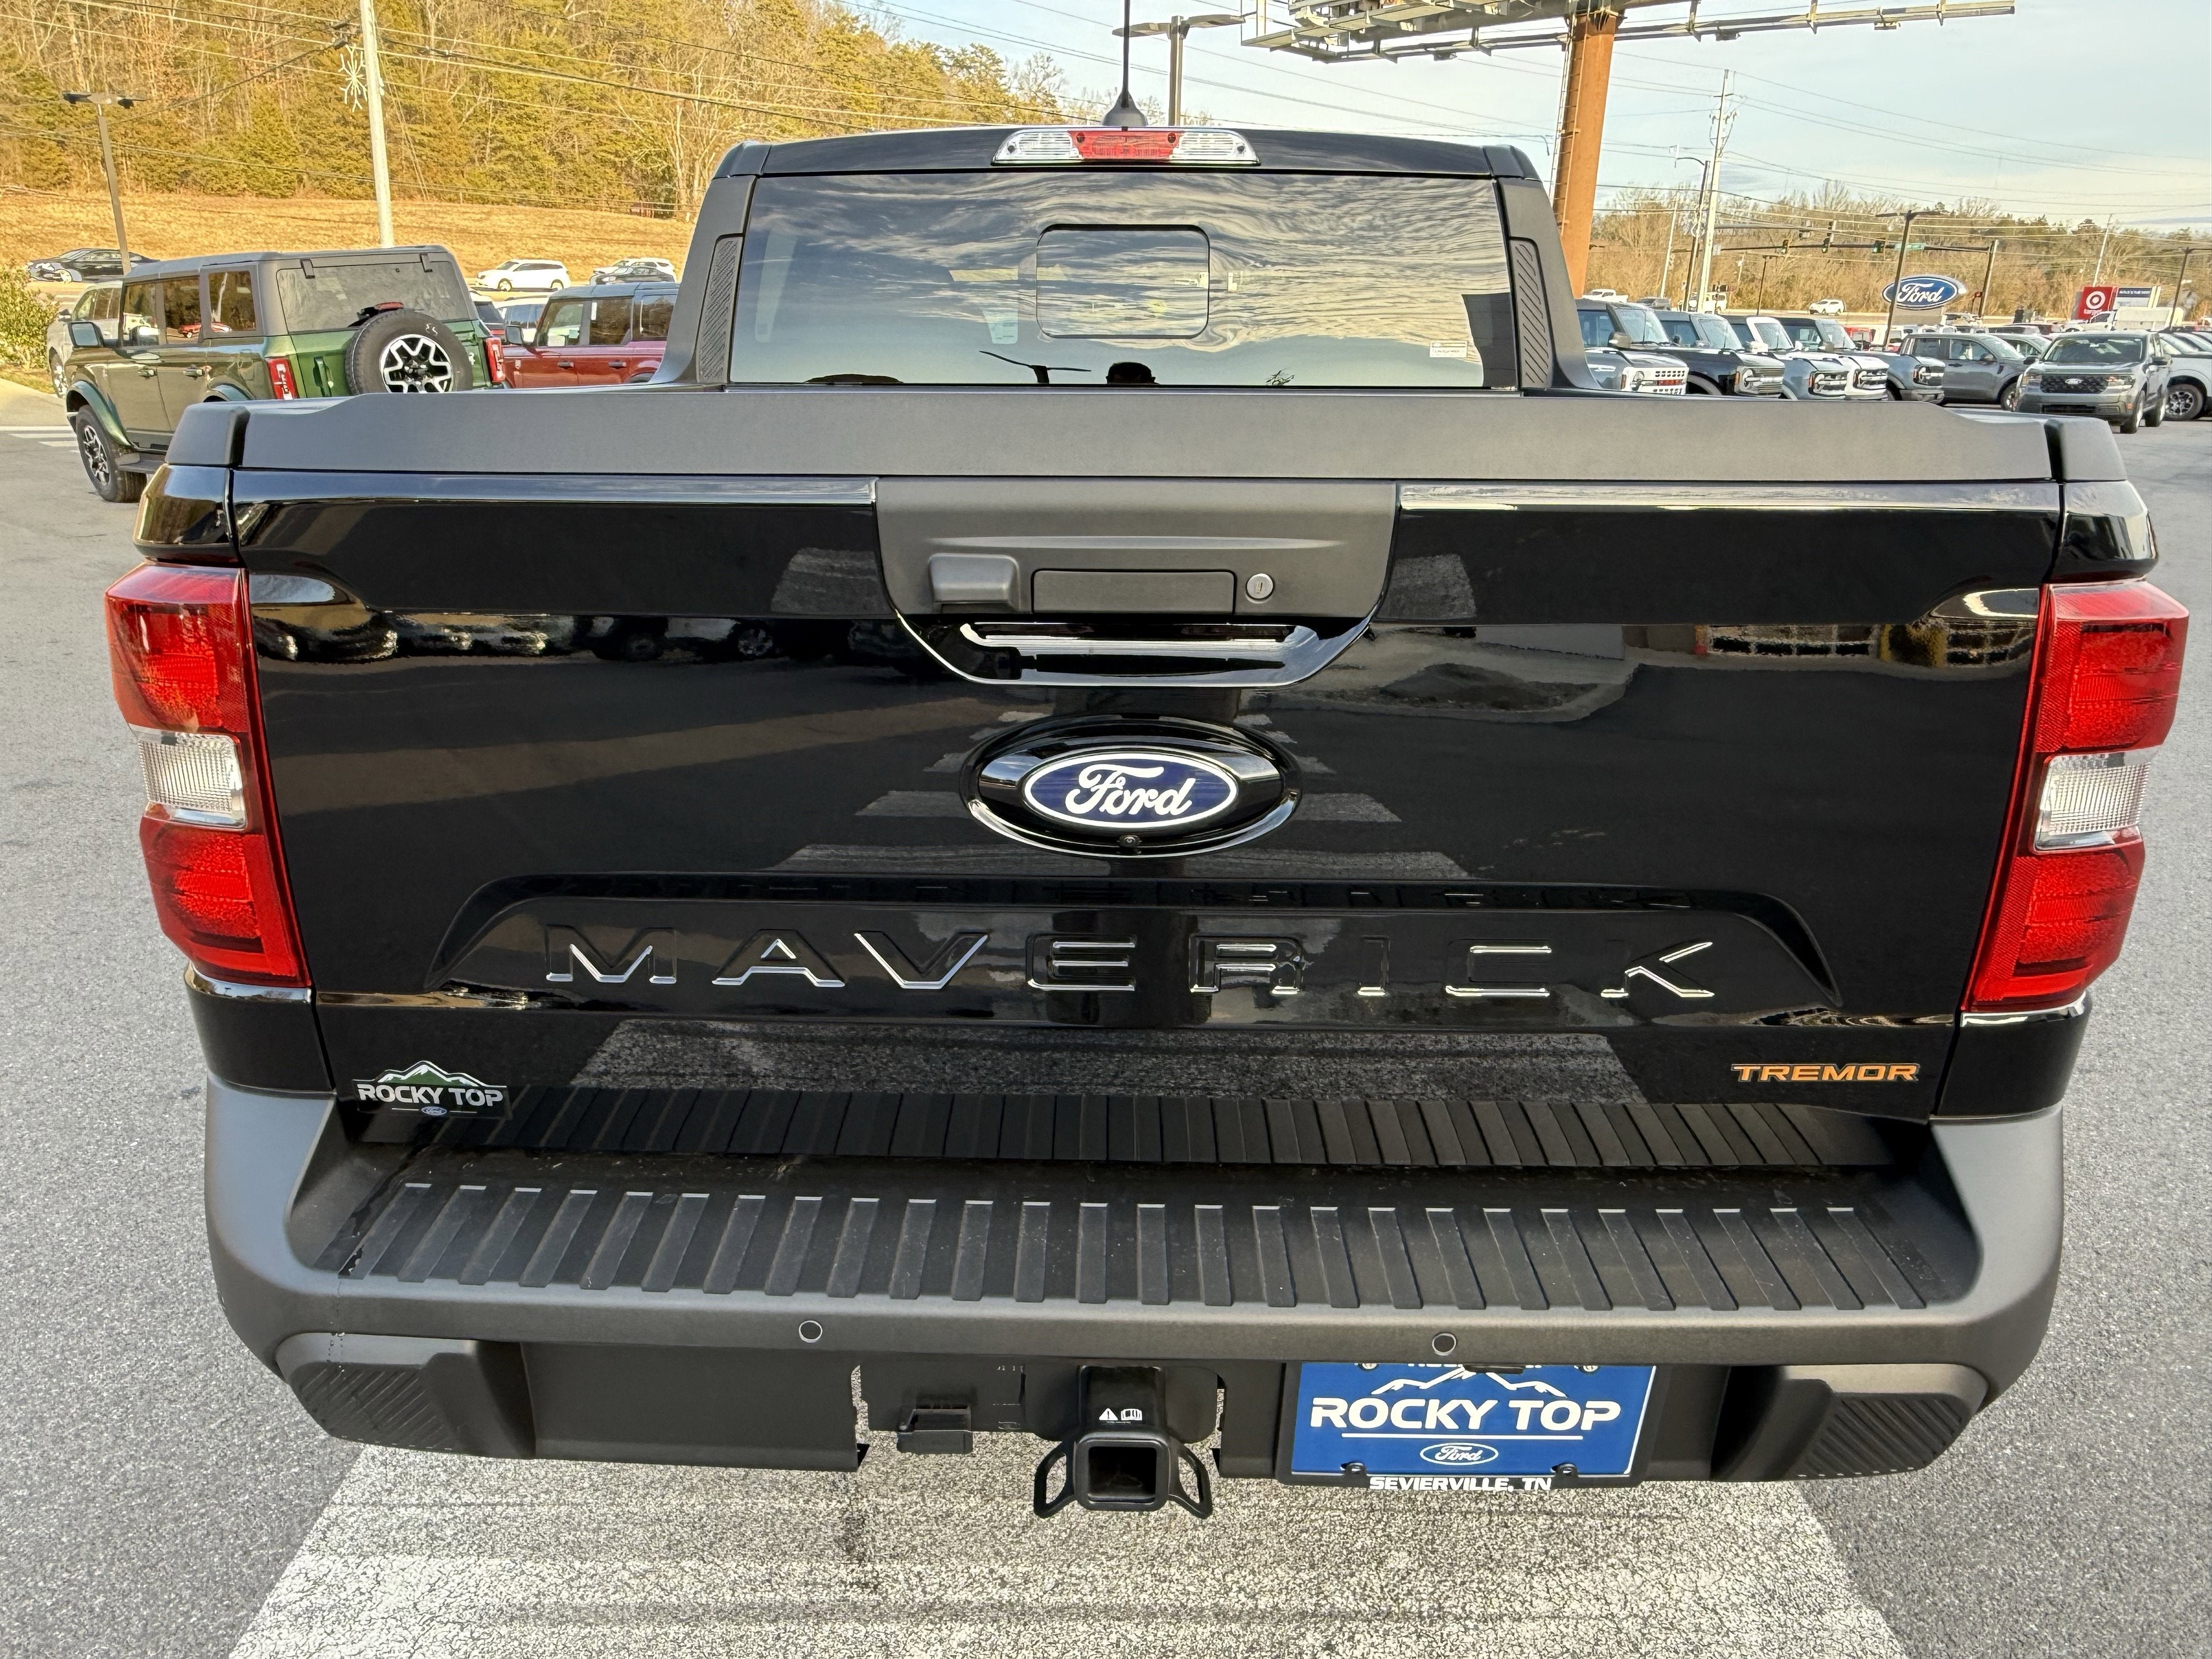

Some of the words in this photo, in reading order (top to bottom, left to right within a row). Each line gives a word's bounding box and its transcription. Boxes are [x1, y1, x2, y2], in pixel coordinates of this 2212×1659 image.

[1897, 282, 1945, 303] Ford
[1065, 763, 1197, 816] Ford
[545, 928, 1715, 999] MAVERICK
[1731, 1063, 1919, 1081] TREMOR
[357, 1084, 444, 1104] ROCKY
[448, 1087, 504, 1107] TOP
[1310, 1397, 1498, 1430] ROCKY
[1508, 1399, 1622, 1431] TOP
[1434, 1444, 1483, 1462] Ford
[1521, 1477, 1553, 1491] TN
